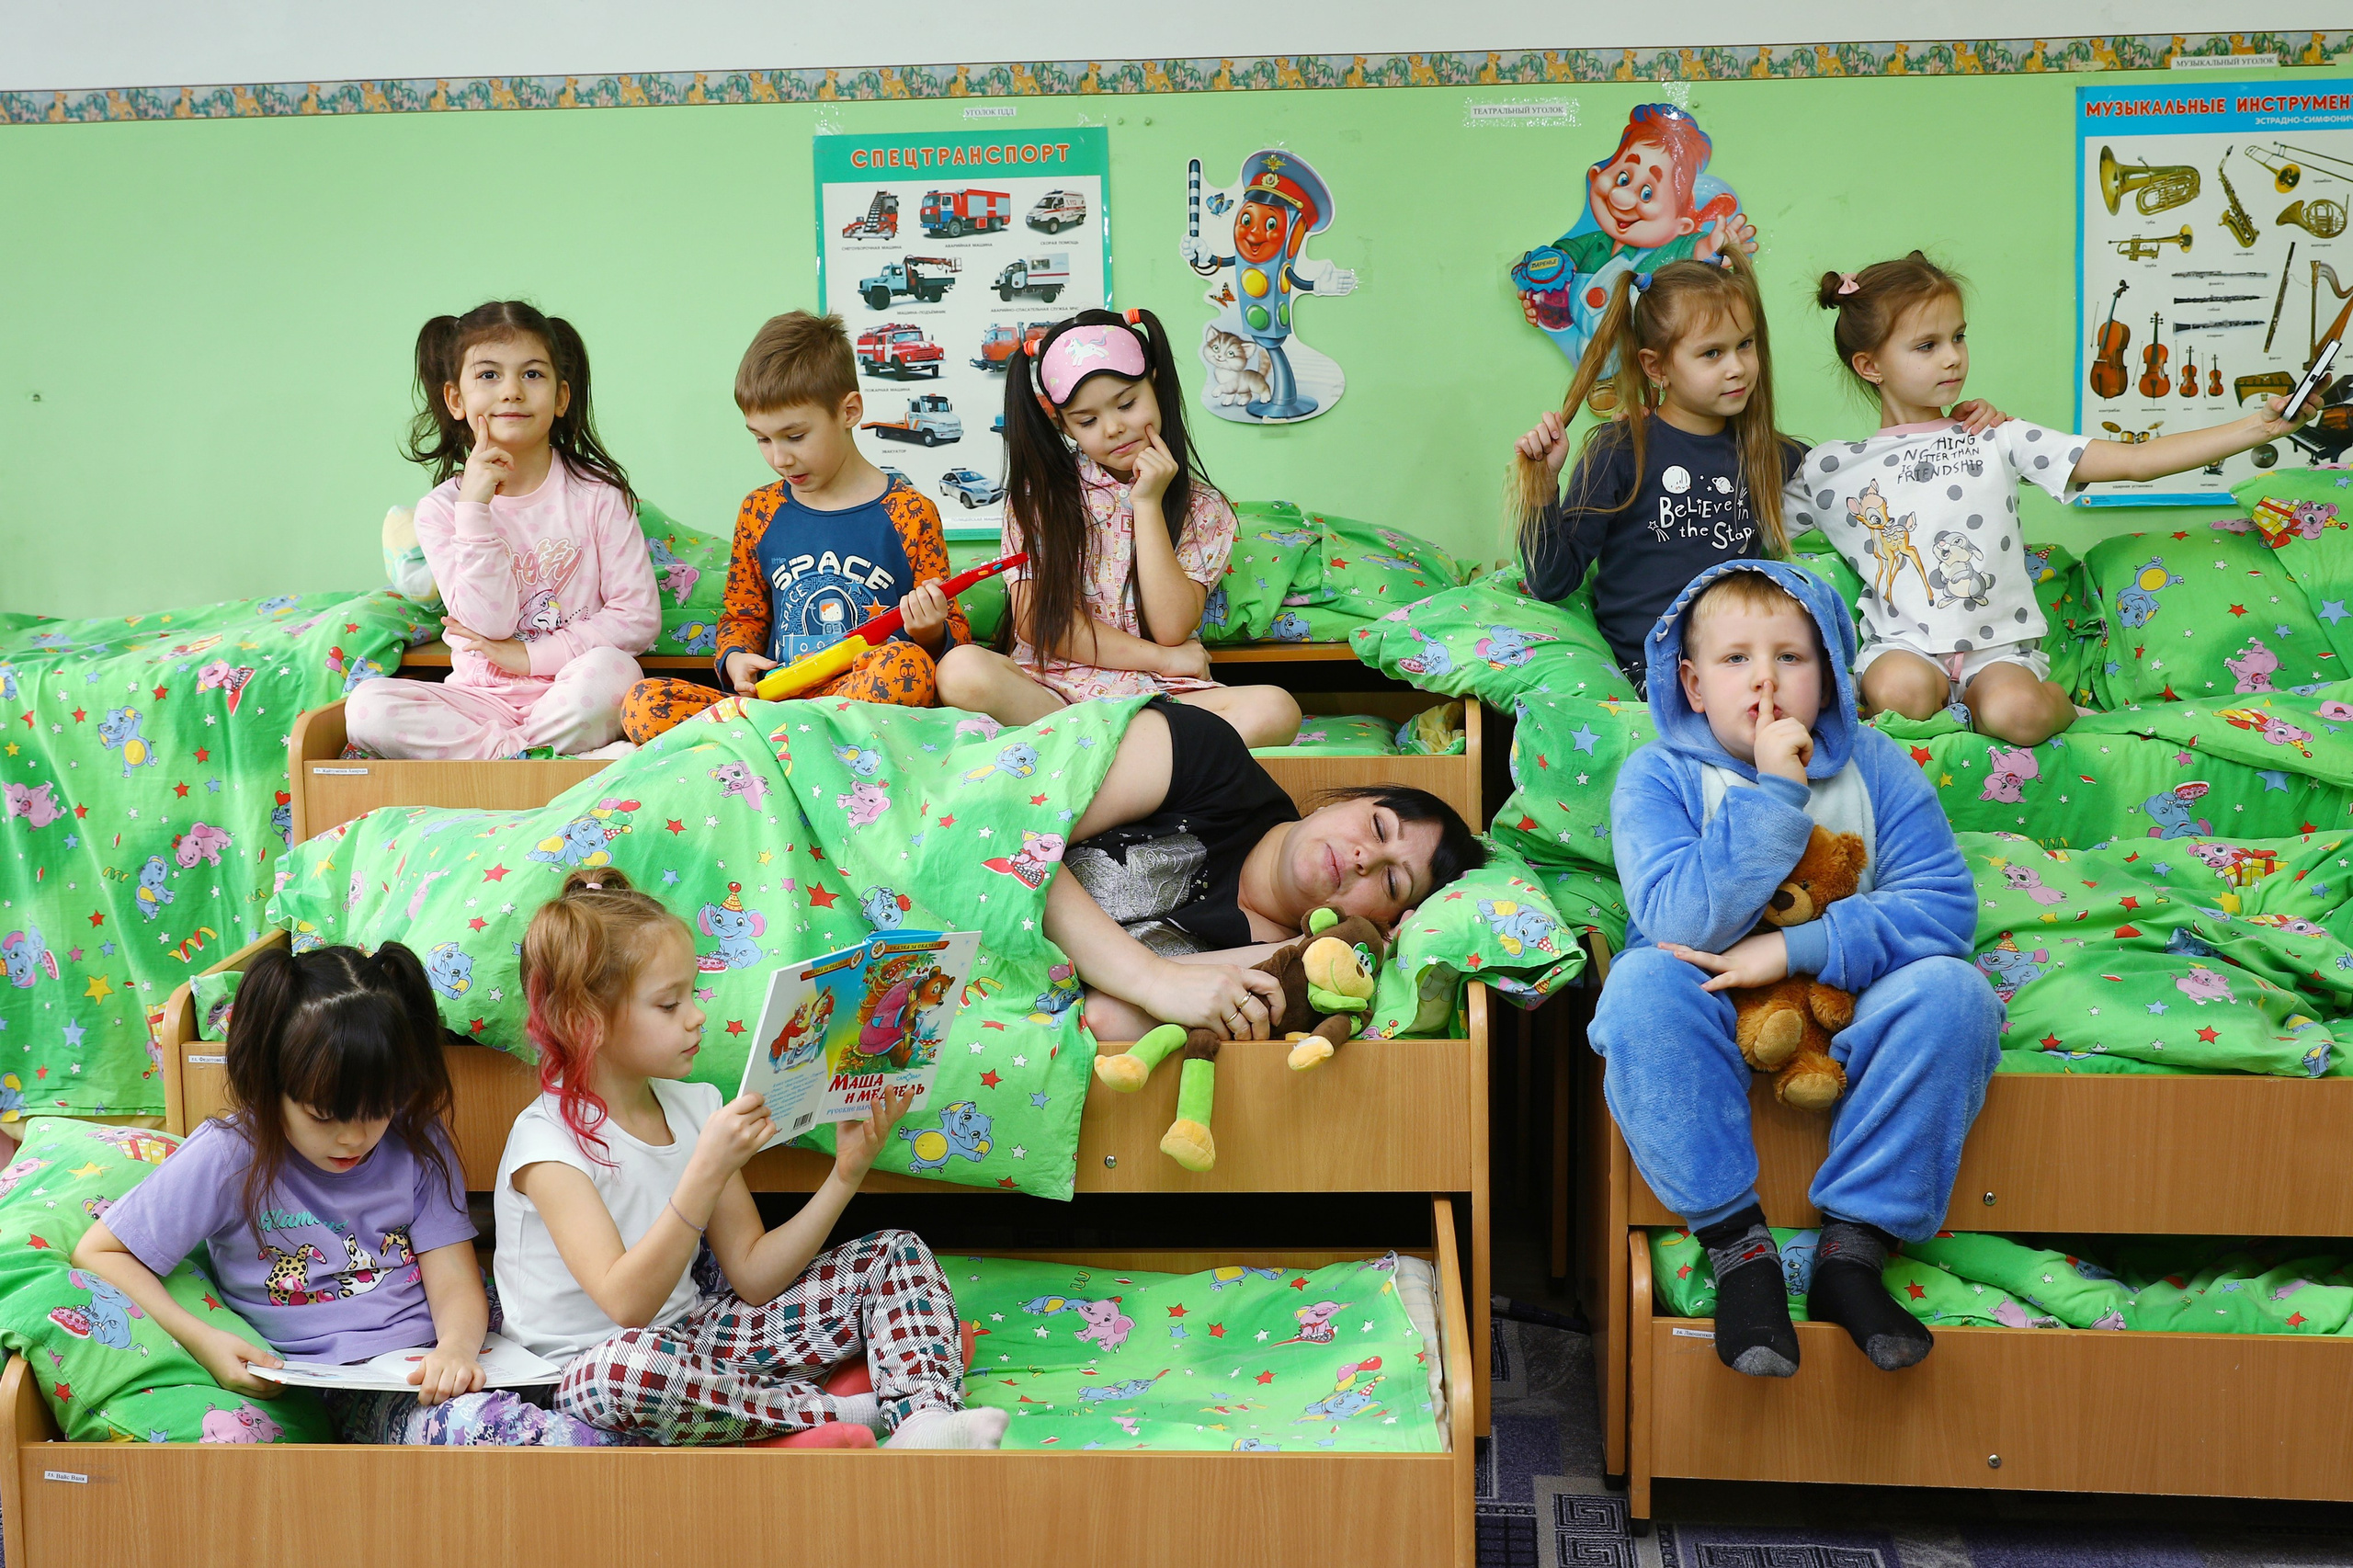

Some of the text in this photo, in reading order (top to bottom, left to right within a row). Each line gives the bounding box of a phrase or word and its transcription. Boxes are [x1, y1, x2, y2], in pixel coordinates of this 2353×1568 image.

[2176, 57, 2275, 67] МУЗЫКАЛЬНЫЙ УГОЛОК
[965, 108, 1015, 117] УГОЛОК ПДД
[1472, 106, 1564, 115] ТЕАТРАЛЬНЫЙ УГОЛОК
[2085, 94, 2353, 118] МУЗЫКАЛЬНЫЕ ИНСТРУМЕН
[850, 142, 1071, 171] СПЕЦТРАНСПОРТ
[1951, 447, 1980, 460] THAN
[1897, 460, 1984, 484] FRIENDSHIP
[1737, 499, 1749, 520] in
[1679, 518, 1709, 538] the
[771, 556, 787, 565] little
[771, 550, 895, 591] SPACE
[780, 583, 808, 631] SPACE
